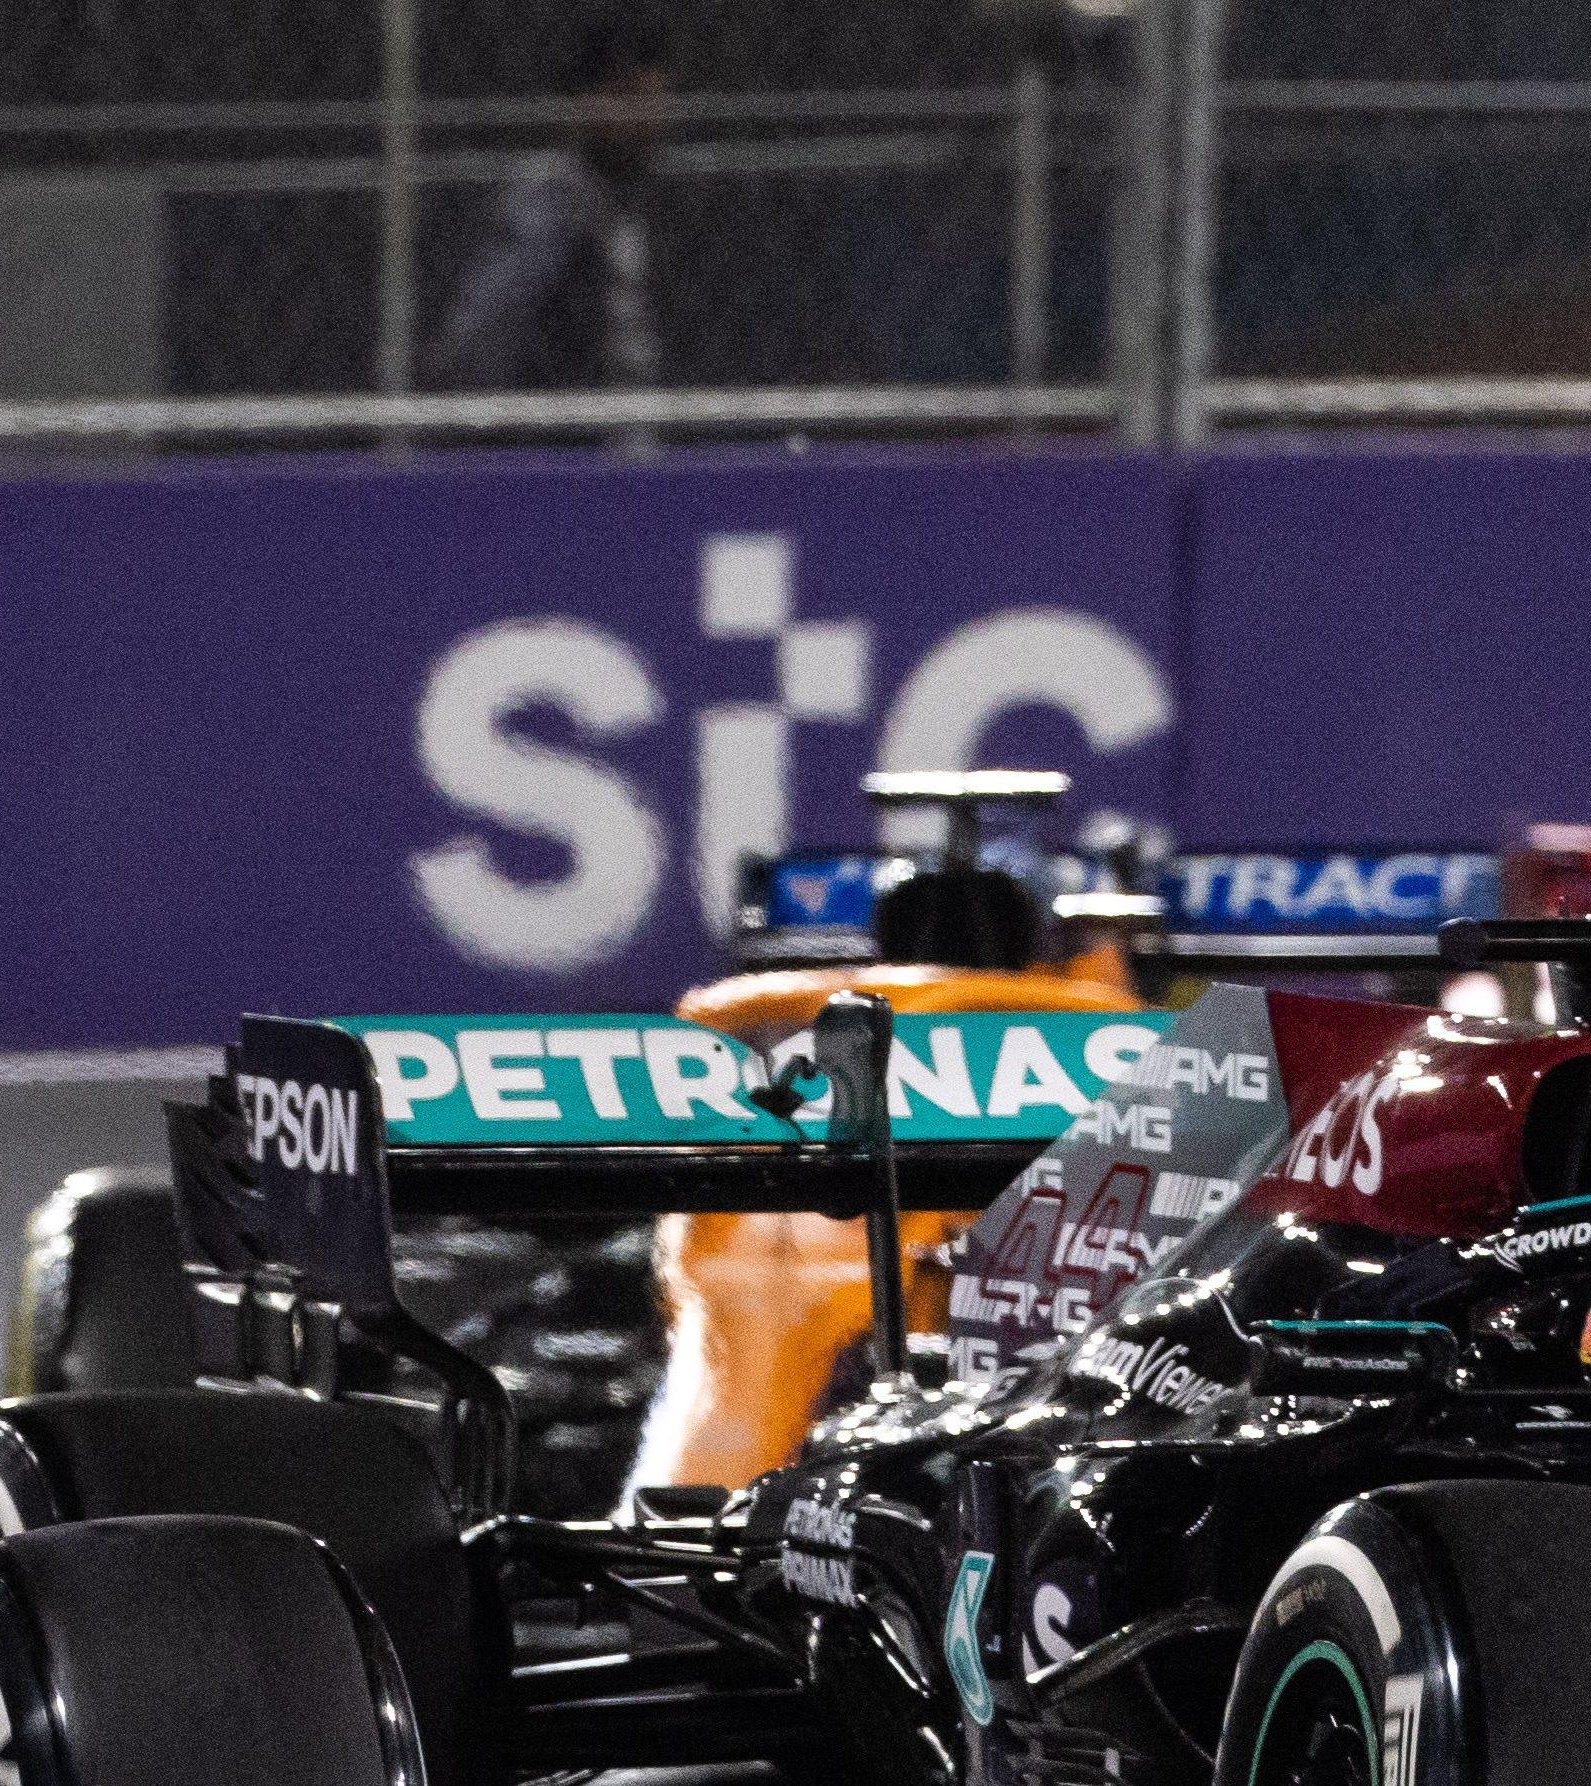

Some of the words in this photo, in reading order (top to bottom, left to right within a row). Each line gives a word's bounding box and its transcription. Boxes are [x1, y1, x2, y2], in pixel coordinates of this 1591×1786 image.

[1167, 1045, 1270, 1100] AMG
[237, 1075, 360, 1177] EPSON
[1070, 1099, 1173, 1153] AMG
